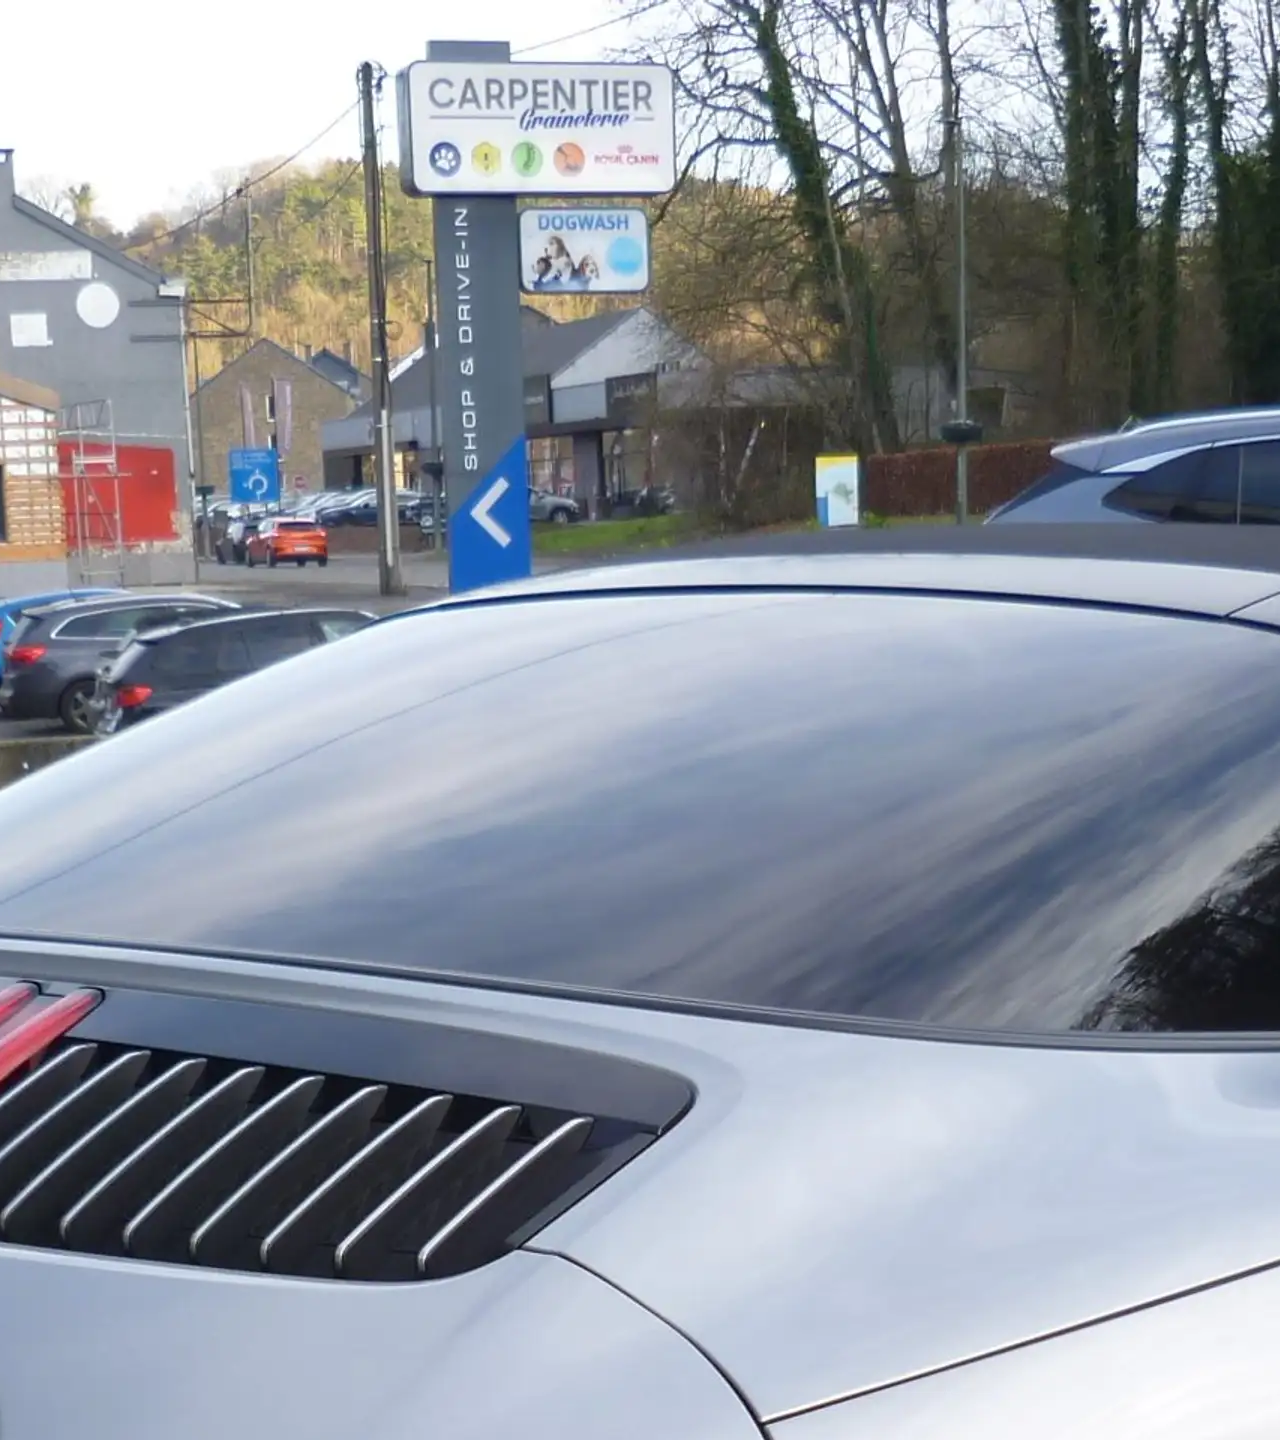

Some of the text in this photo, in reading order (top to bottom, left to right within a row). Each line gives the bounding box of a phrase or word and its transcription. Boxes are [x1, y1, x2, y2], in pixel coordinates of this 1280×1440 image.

[428, 77, 653, 113] CARPENTIER
[538, 213, 630, 232] DOGWASH
[454, 207, 478, 471] SHOP & DRIVE-IN
